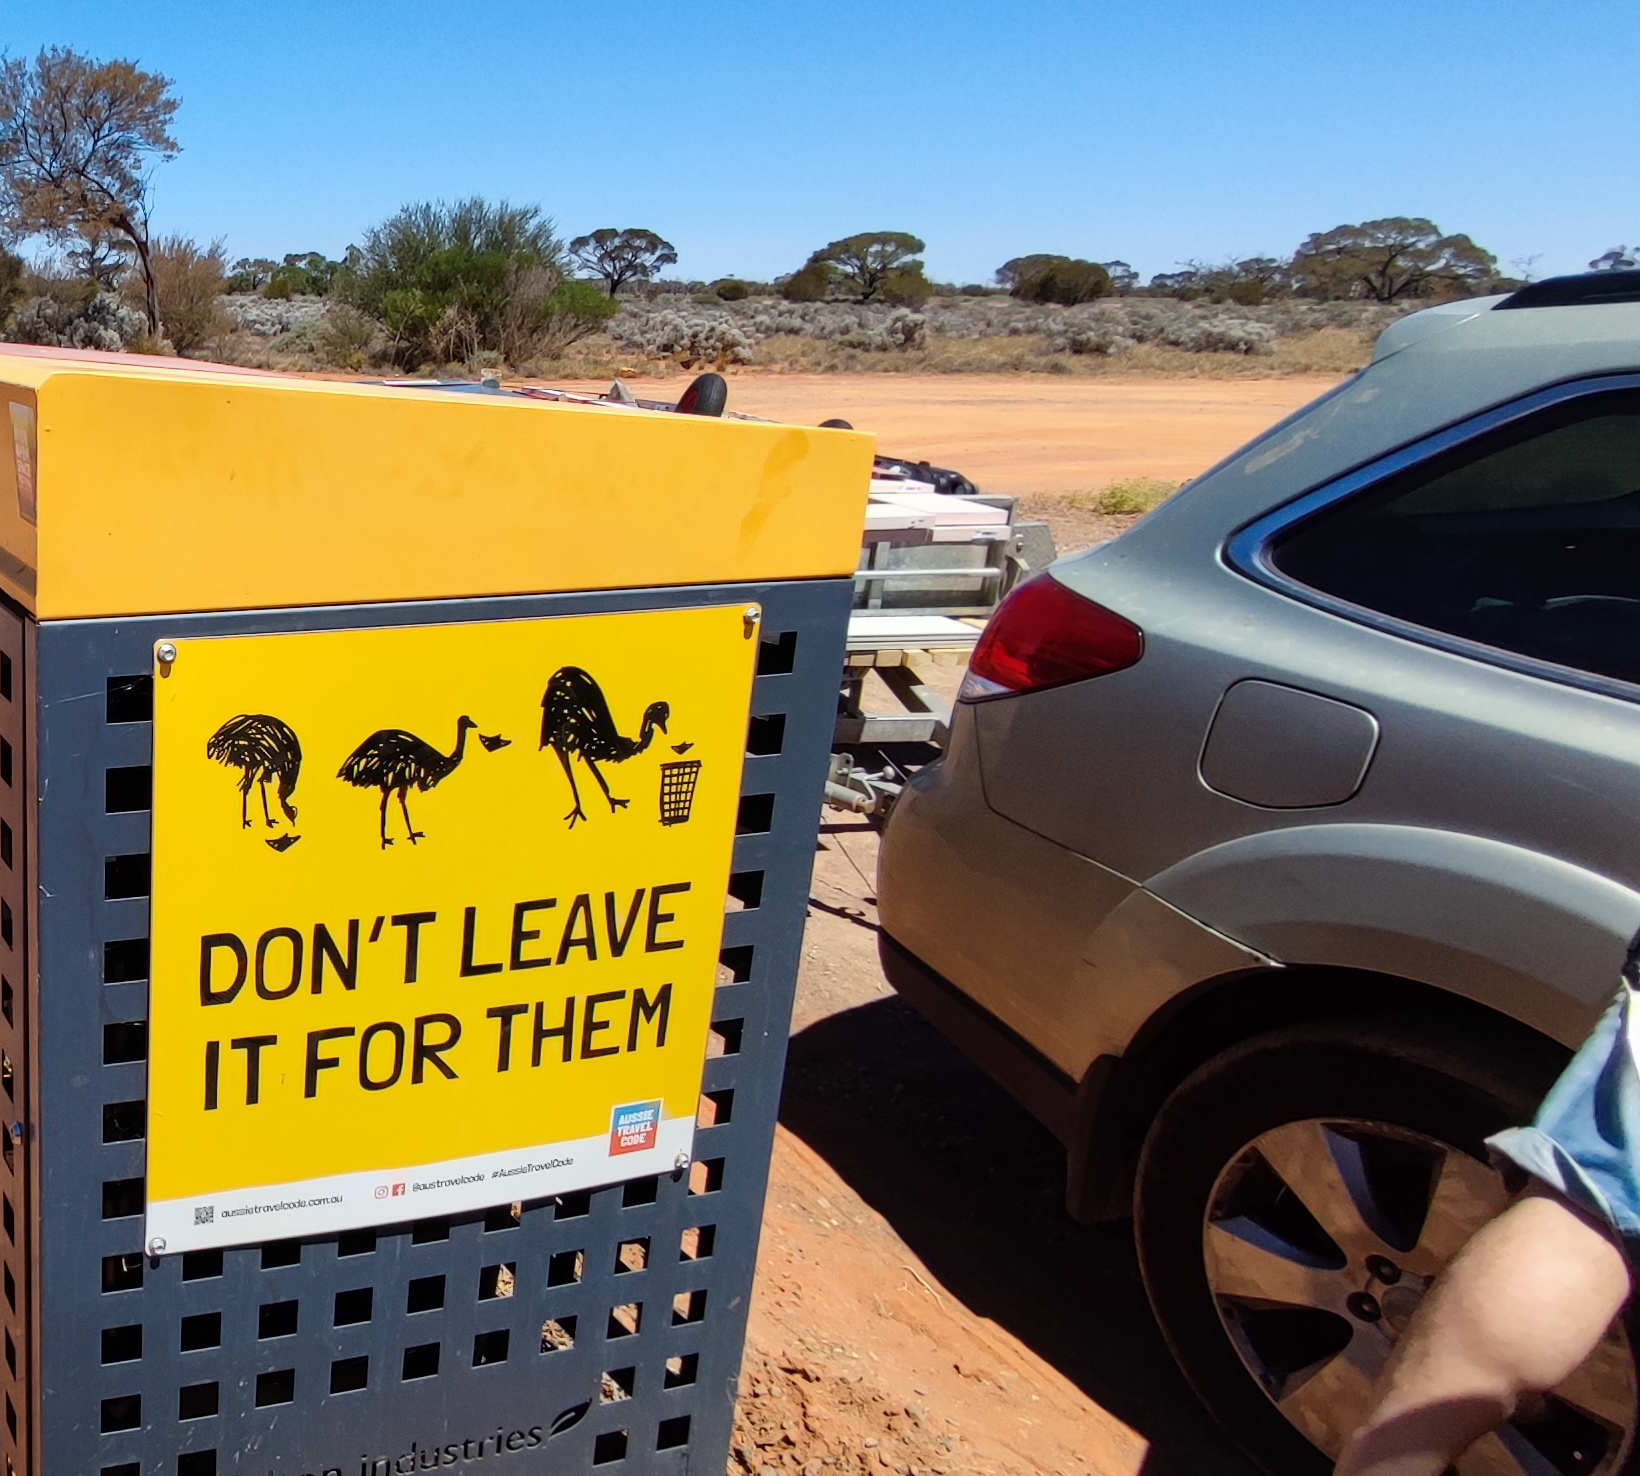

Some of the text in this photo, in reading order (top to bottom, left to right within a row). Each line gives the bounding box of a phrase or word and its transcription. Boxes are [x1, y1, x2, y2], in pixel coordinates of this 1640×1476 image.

[200, 881, 692, 1007] DON'T LEAVE
[203, 983, 673, 1112] IT FOR THEM
[617, 1120, 654, 1138] TRAVEL
[618, 1109, 655, 1126] AUSSIE
[620, 1132, 647, 1148] CODE
[221, 1156, 574, 1218] aussietravelcode.com.au @austravelcode #AussieTravelCode
